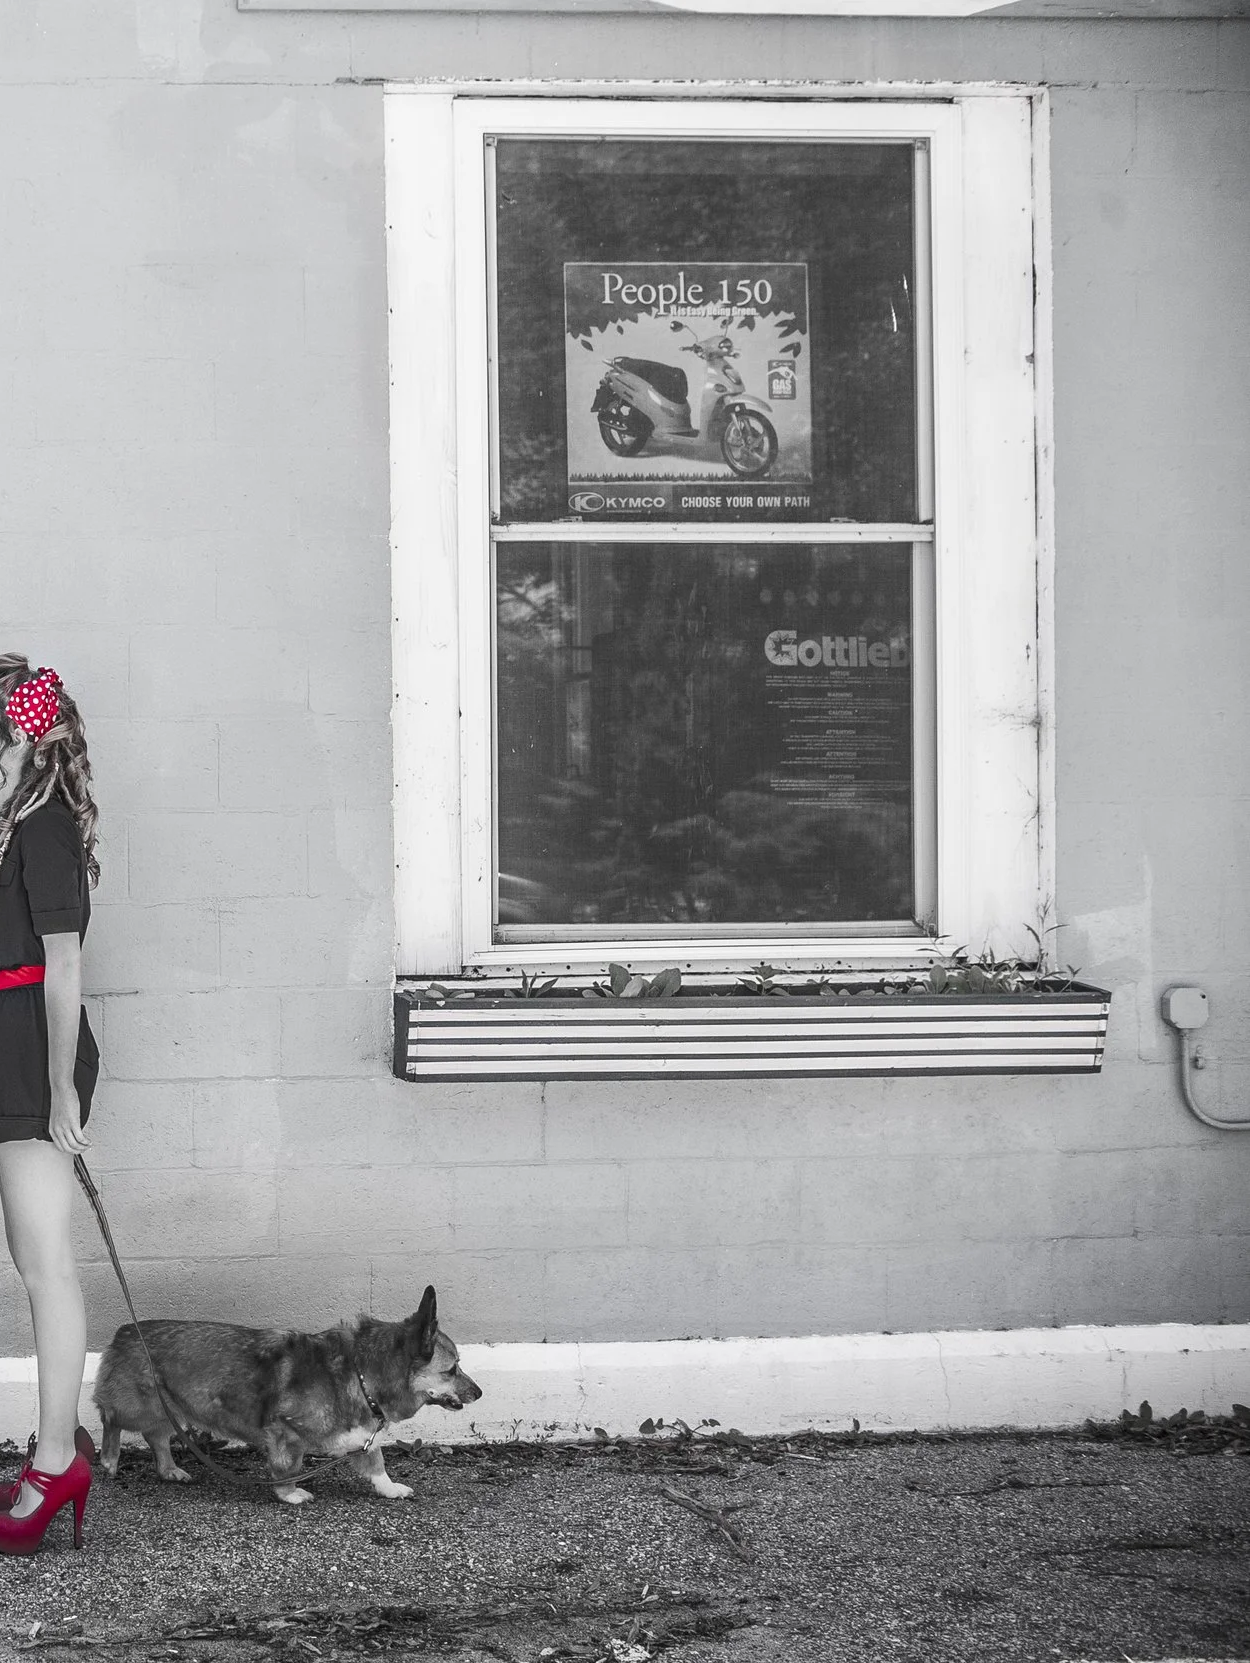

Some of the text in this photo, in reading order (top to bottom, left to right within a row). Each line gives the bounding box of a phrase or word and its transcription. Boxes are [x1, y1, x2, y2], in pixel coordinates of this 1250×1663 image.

[601, 271, 772, 316] People 150
[773, 379, 791, 392] GAS
[606, 497, 665, 508] KYMCO
[681, 496, 722, 508] CHOOSE
[726, 496, 754, 508] YOUR
[757, 496, 781, 508] OWN
[784, 496, 810, 508] PATH
[764, 630, 910, 667] Gottlieb
